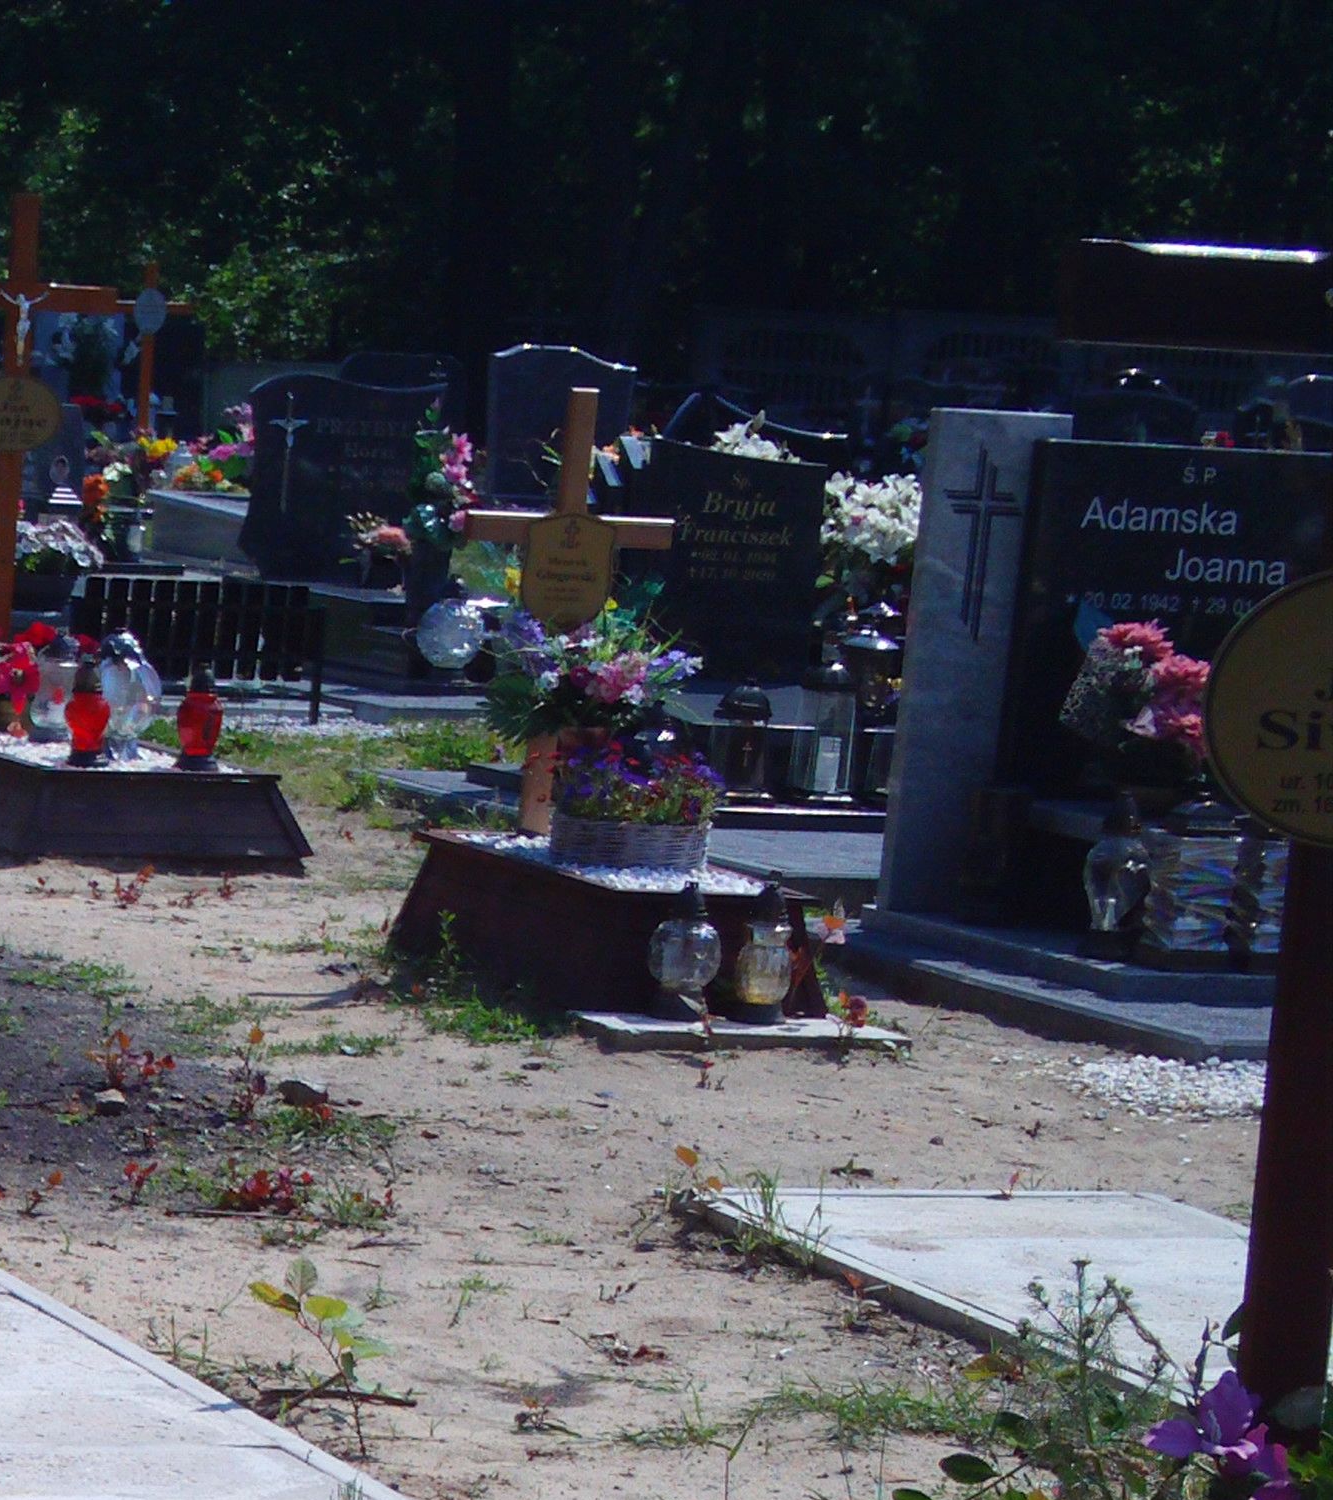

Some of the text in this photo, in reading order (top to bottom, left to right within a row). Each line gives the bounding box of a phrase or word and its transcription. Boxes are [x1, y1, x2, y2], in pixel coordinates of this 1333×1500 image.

[699, 489, 778, 522] Bryja
[1080, 495, 1239, 537] Adamska
[679, 521, 795, 547] Franciszek
[1164, 548, 1288, 586] Joanna
[1257, 708, 1333, 751] Si
